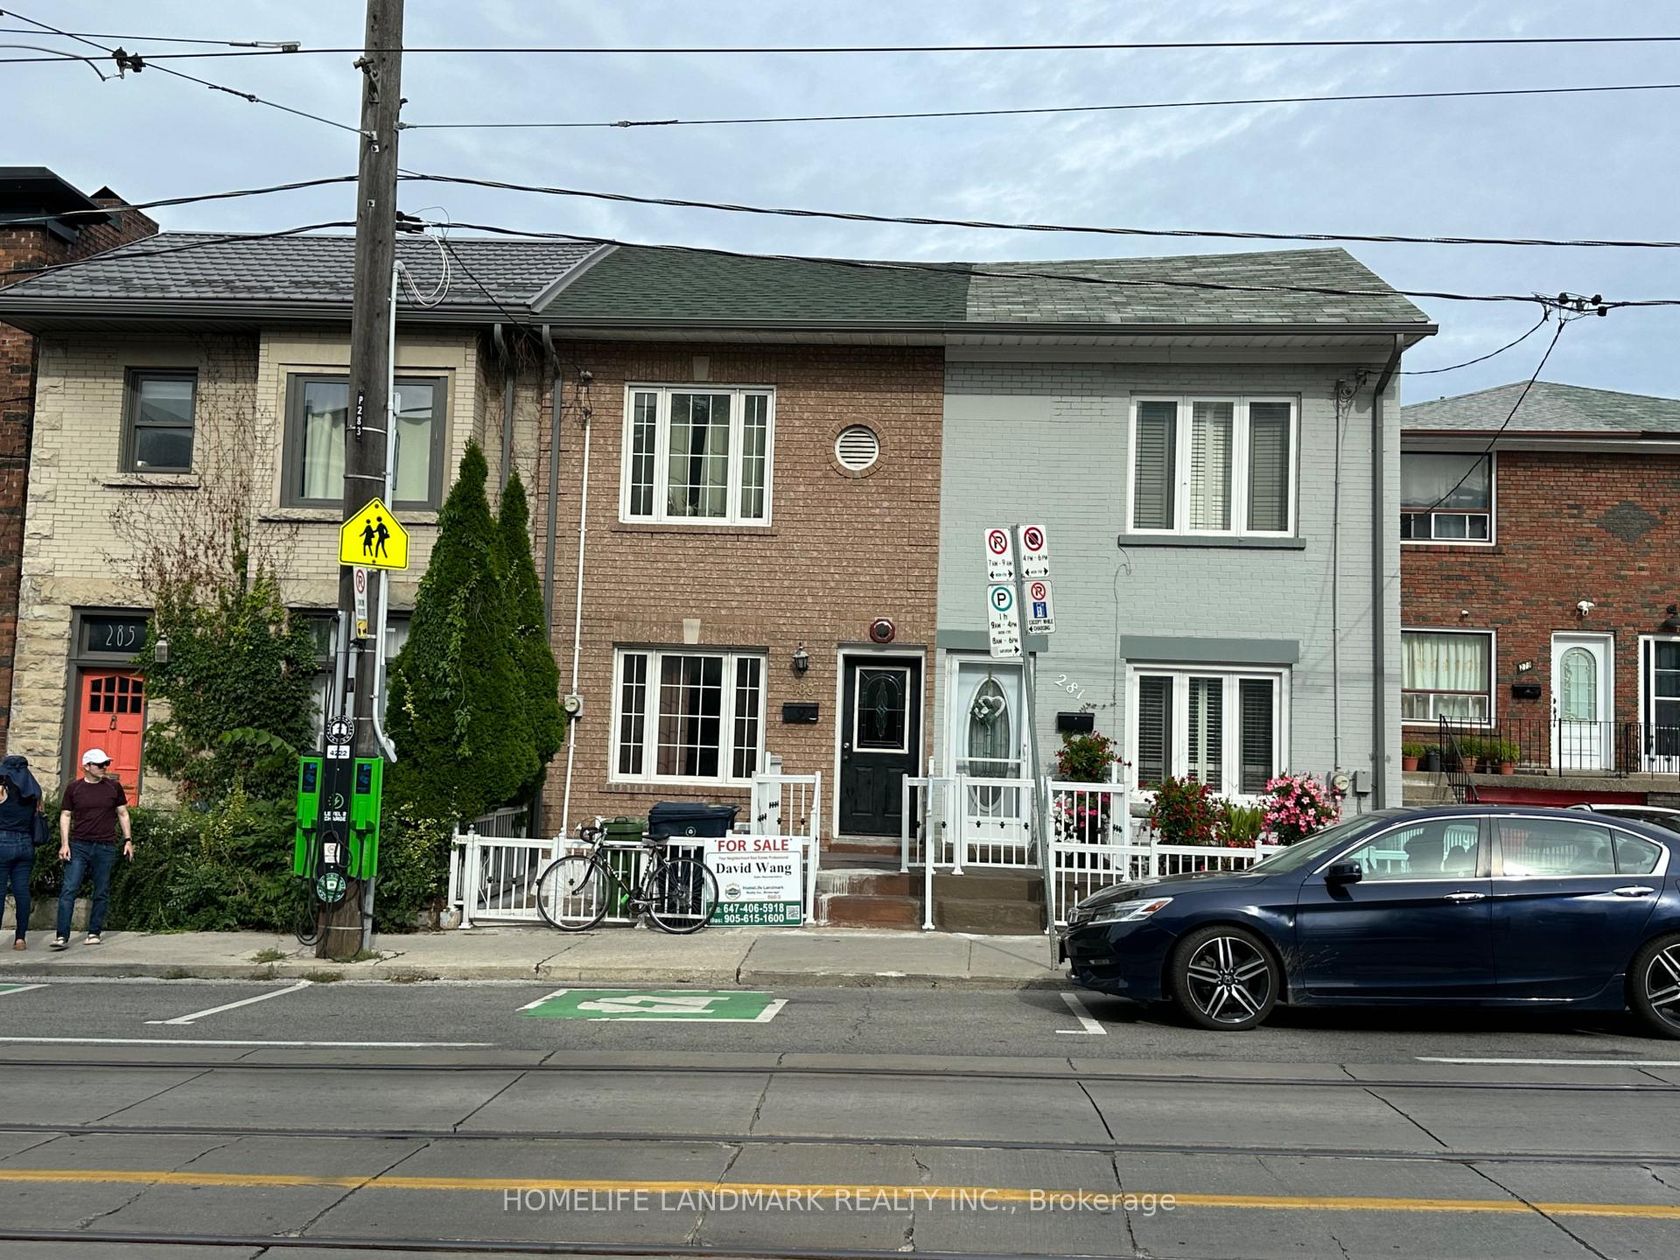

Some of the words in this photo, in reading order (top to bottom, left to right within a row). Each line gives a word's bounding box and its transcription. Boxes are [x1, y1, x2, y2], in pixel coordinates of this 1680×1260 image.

[106, 624, 135, 647] 285
[1054, 673, 1085, 700] 281
[718, 839, 746, 852] FOR
[753, 839, 789, 852] SALE
[716, 862, 751, 874] David
[756, 862, 792, 876] Wang
[723, 903, 784, 913] 647-406-5918
[724, 913, 784, 923] 905-615-1600
